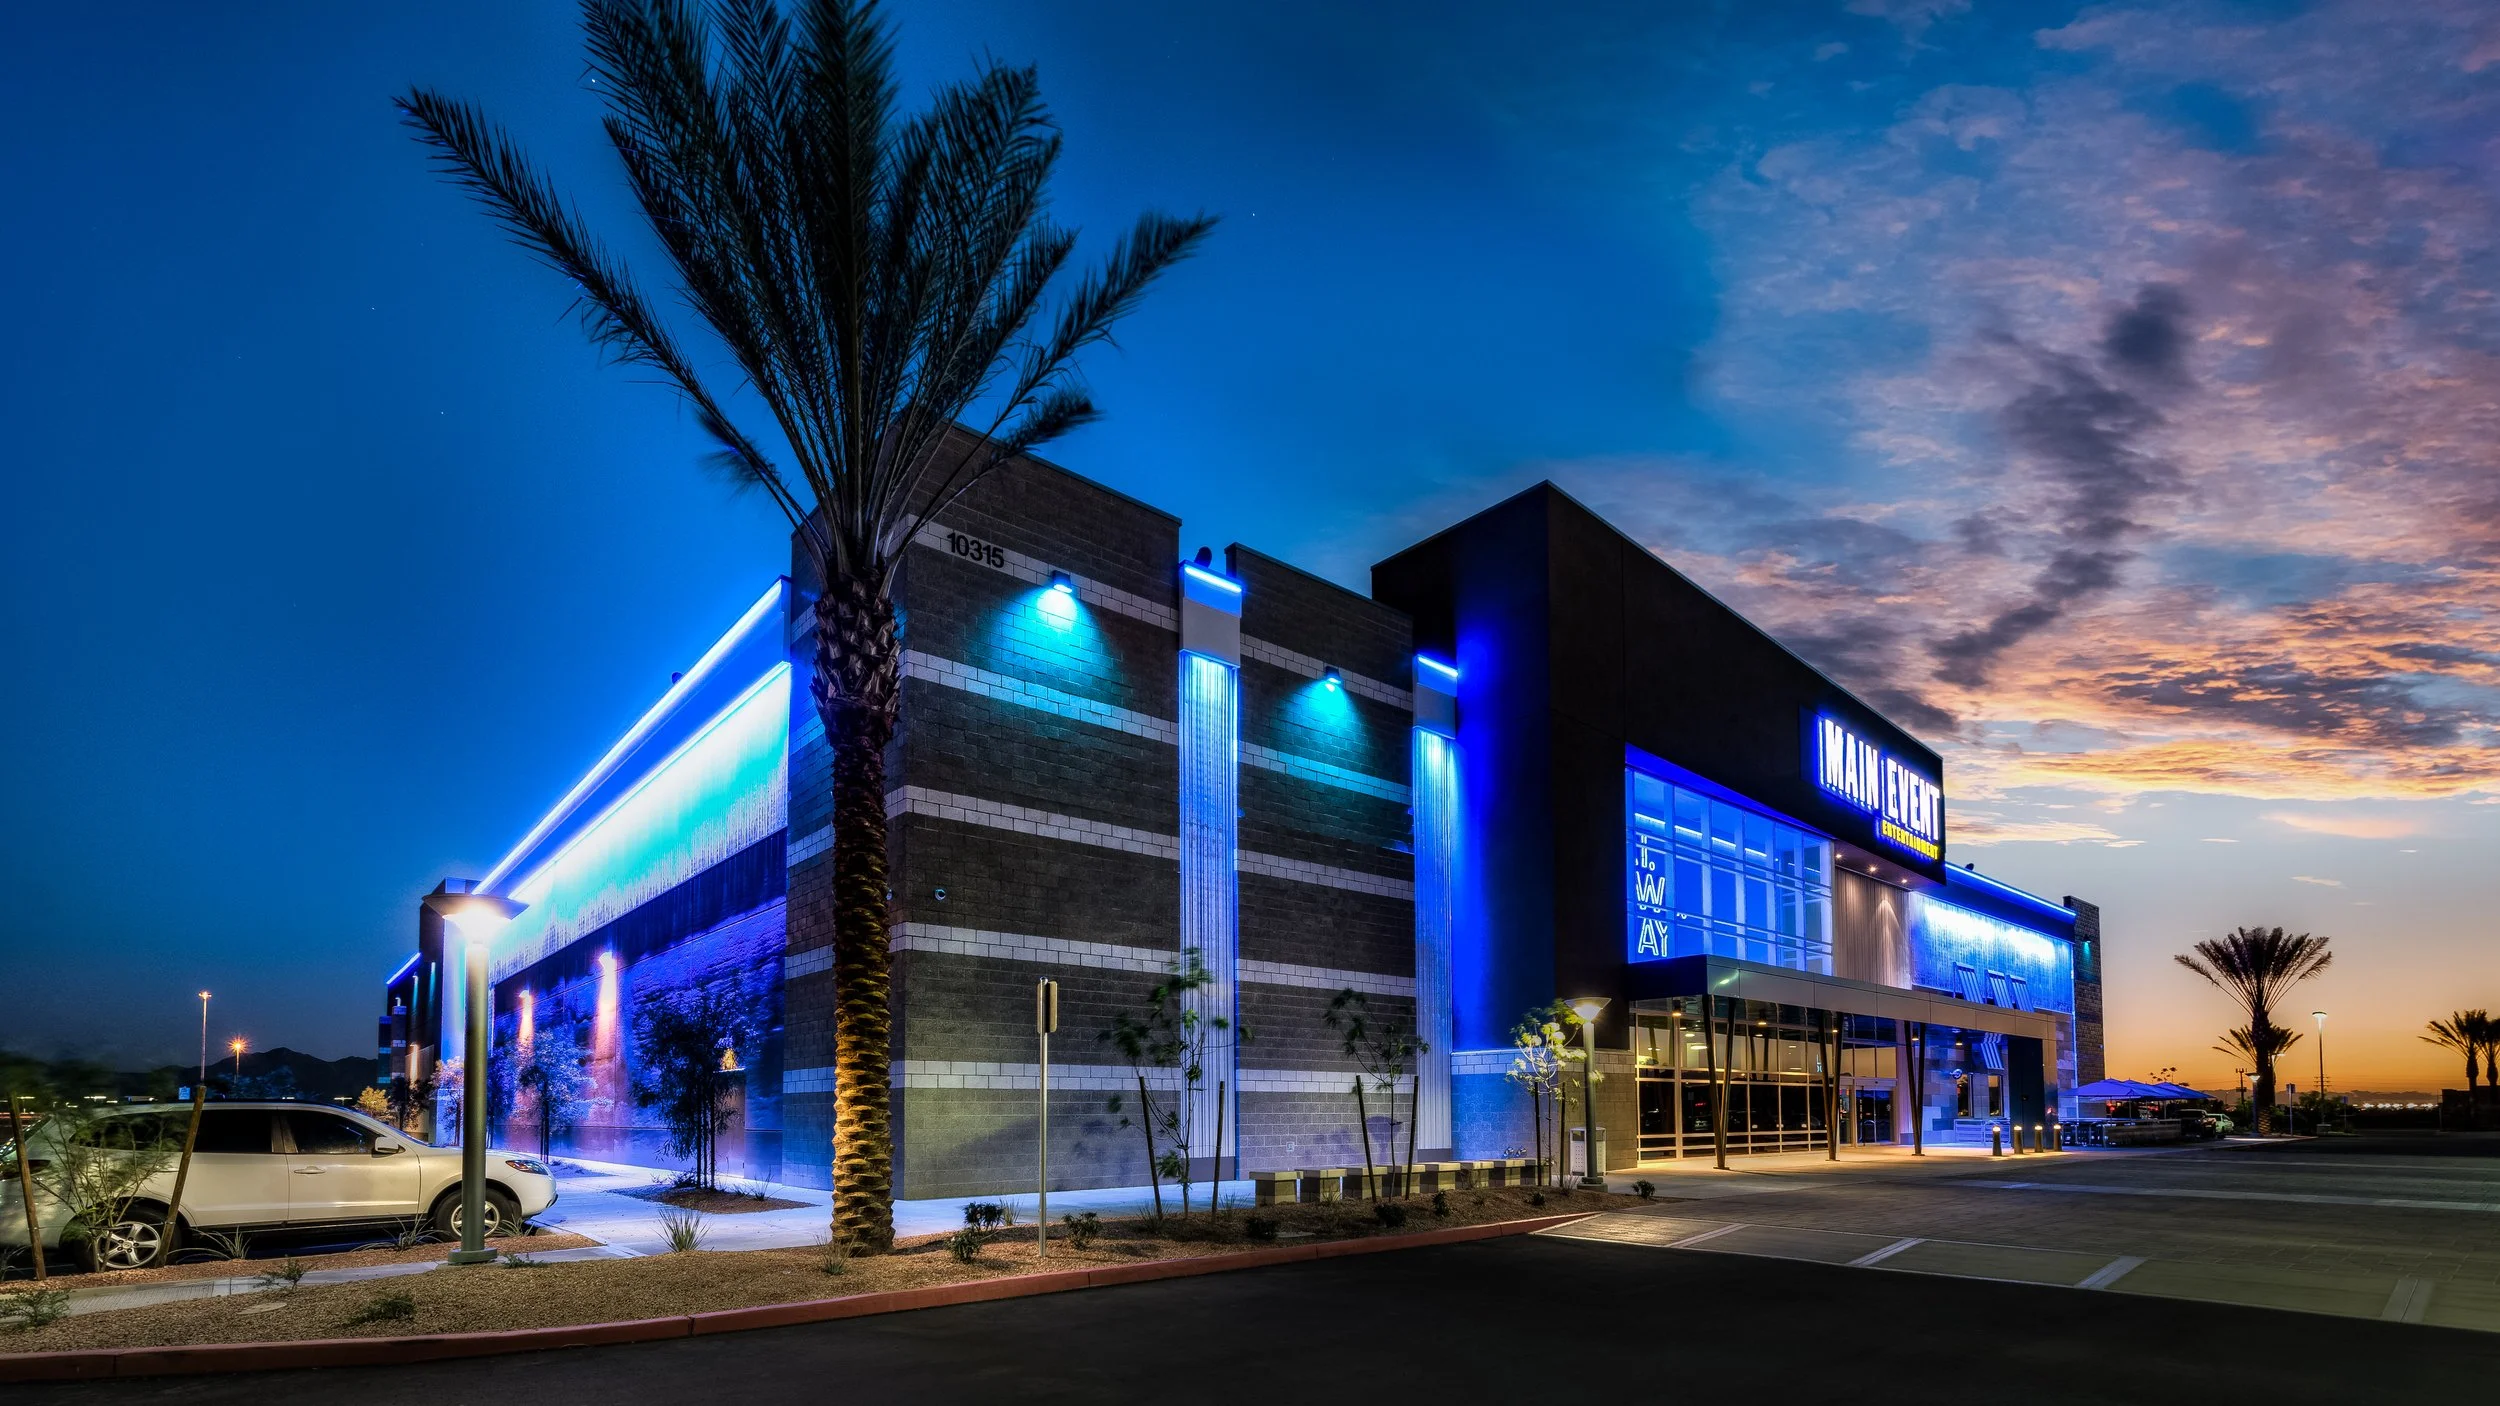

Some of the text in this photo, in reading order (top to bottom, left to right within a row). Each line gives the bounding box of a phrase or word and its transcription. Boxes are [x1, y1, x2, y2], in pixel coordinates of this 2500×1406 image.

[947, 532, 1004, 568] 10315
[1825, 719, 1940, 841] MAIN EVENT
[1882, 820, 1938, 860] ENTERTAINMENT
